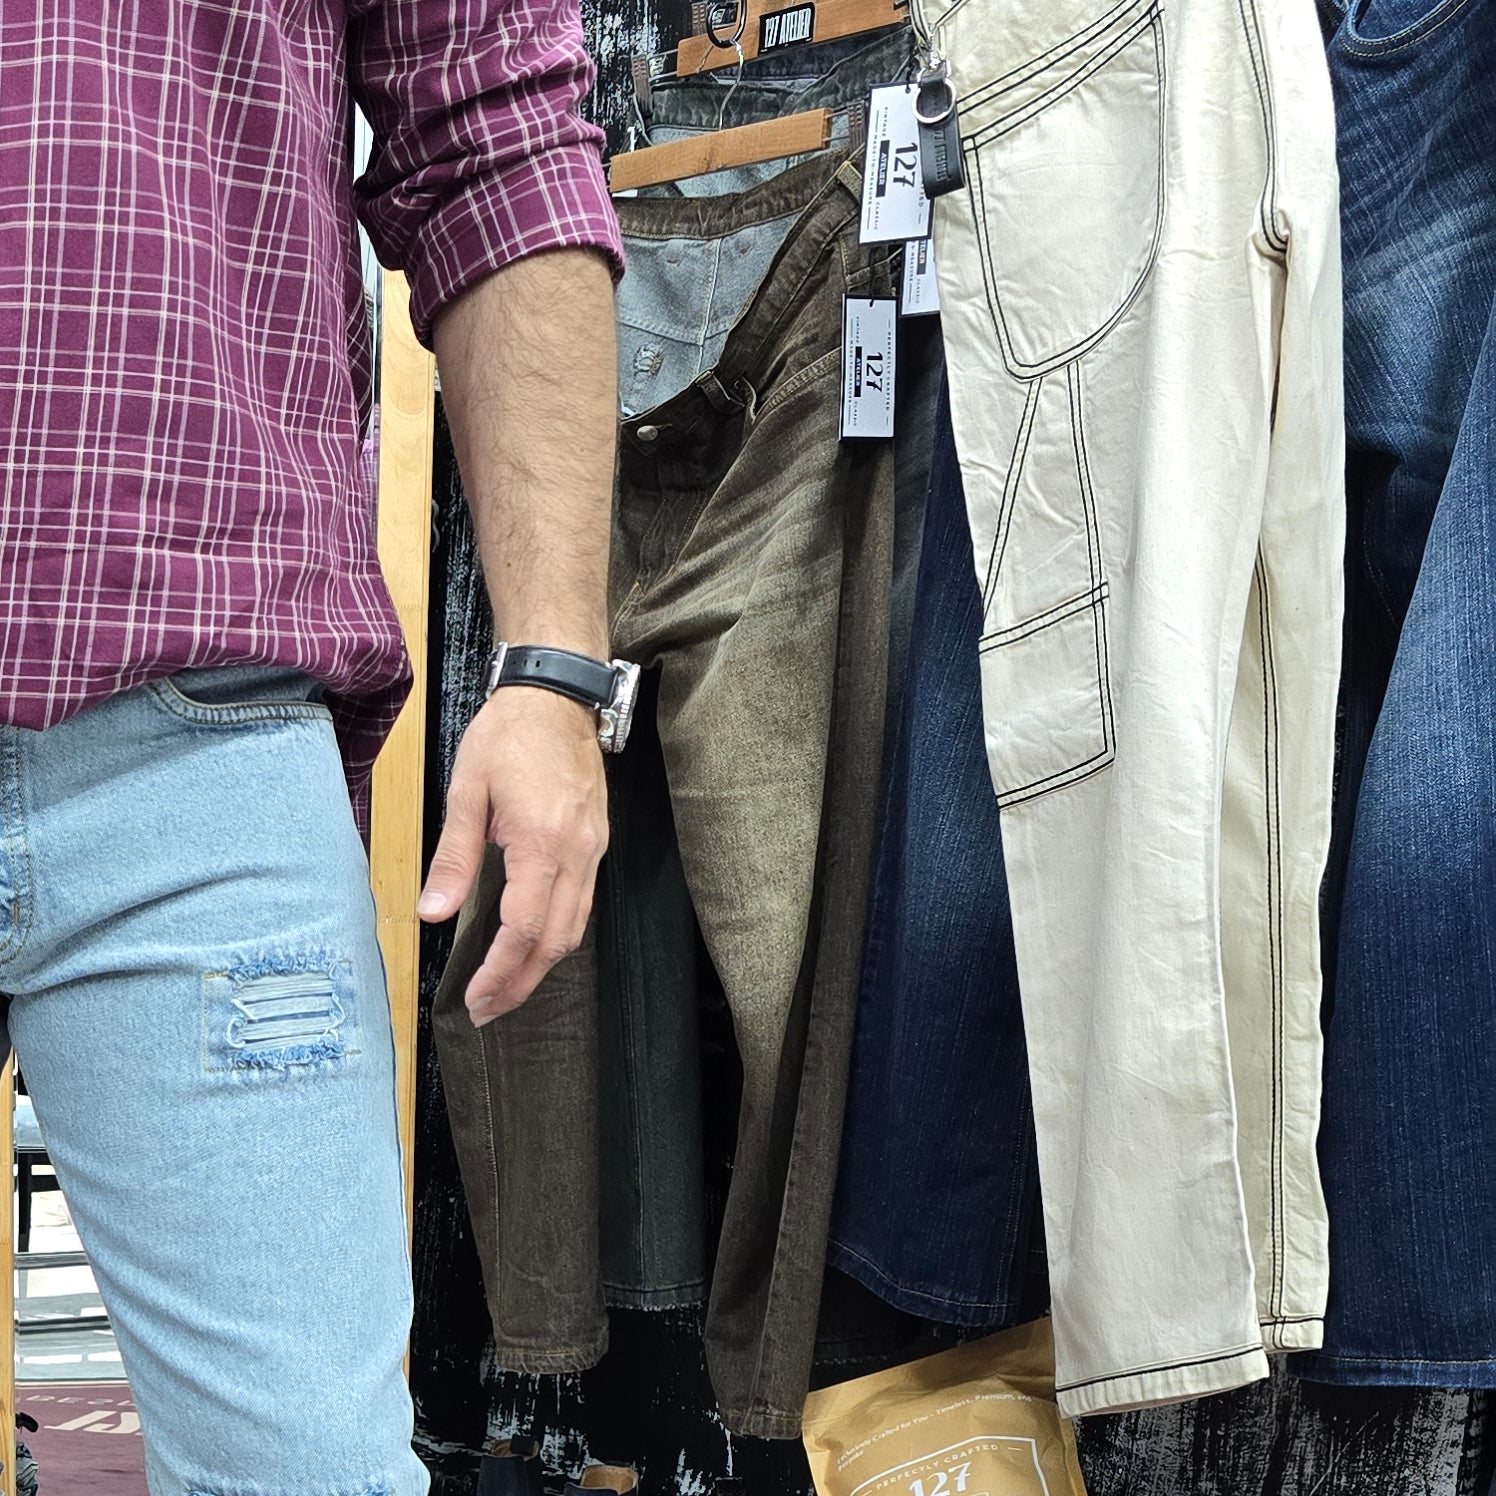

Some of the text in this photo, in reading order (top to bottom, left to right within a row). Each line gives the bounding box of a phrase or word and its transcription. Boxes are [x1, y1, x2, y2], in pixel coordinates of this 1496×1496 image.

[878, 152, 887, 186] ATELIER
[892, 142, 918, 188] 127
[866, 351, 884, 393] 127
[872, 1425, 900, 1441] Crafted
[912, 1415, 928, 1424] You
[875, 1444, 998, 1490] PERFECTLY CRAFTED
